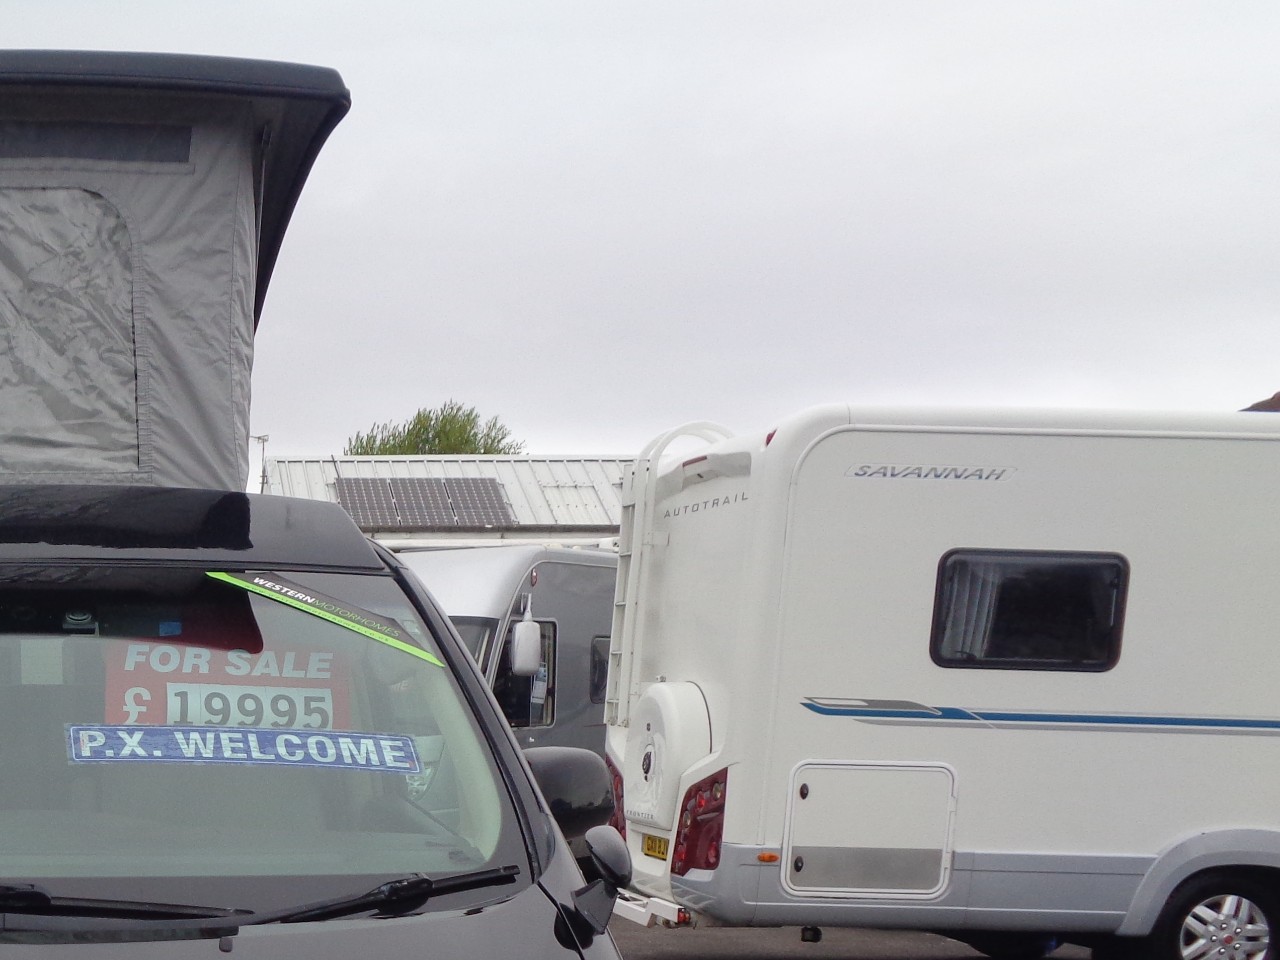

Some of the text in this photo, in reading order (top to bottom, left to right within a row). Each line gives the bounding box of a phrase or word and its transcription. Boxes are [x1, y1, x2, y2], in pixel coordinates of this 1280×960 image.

[853, 464, 1007, 481] SAVANNAH
[663, 490, 750, 519] AUTOTRAIL
[123, 644, 333, 680] FOR SALE
[78, 730, 415, 769] P.X. WELCOME
